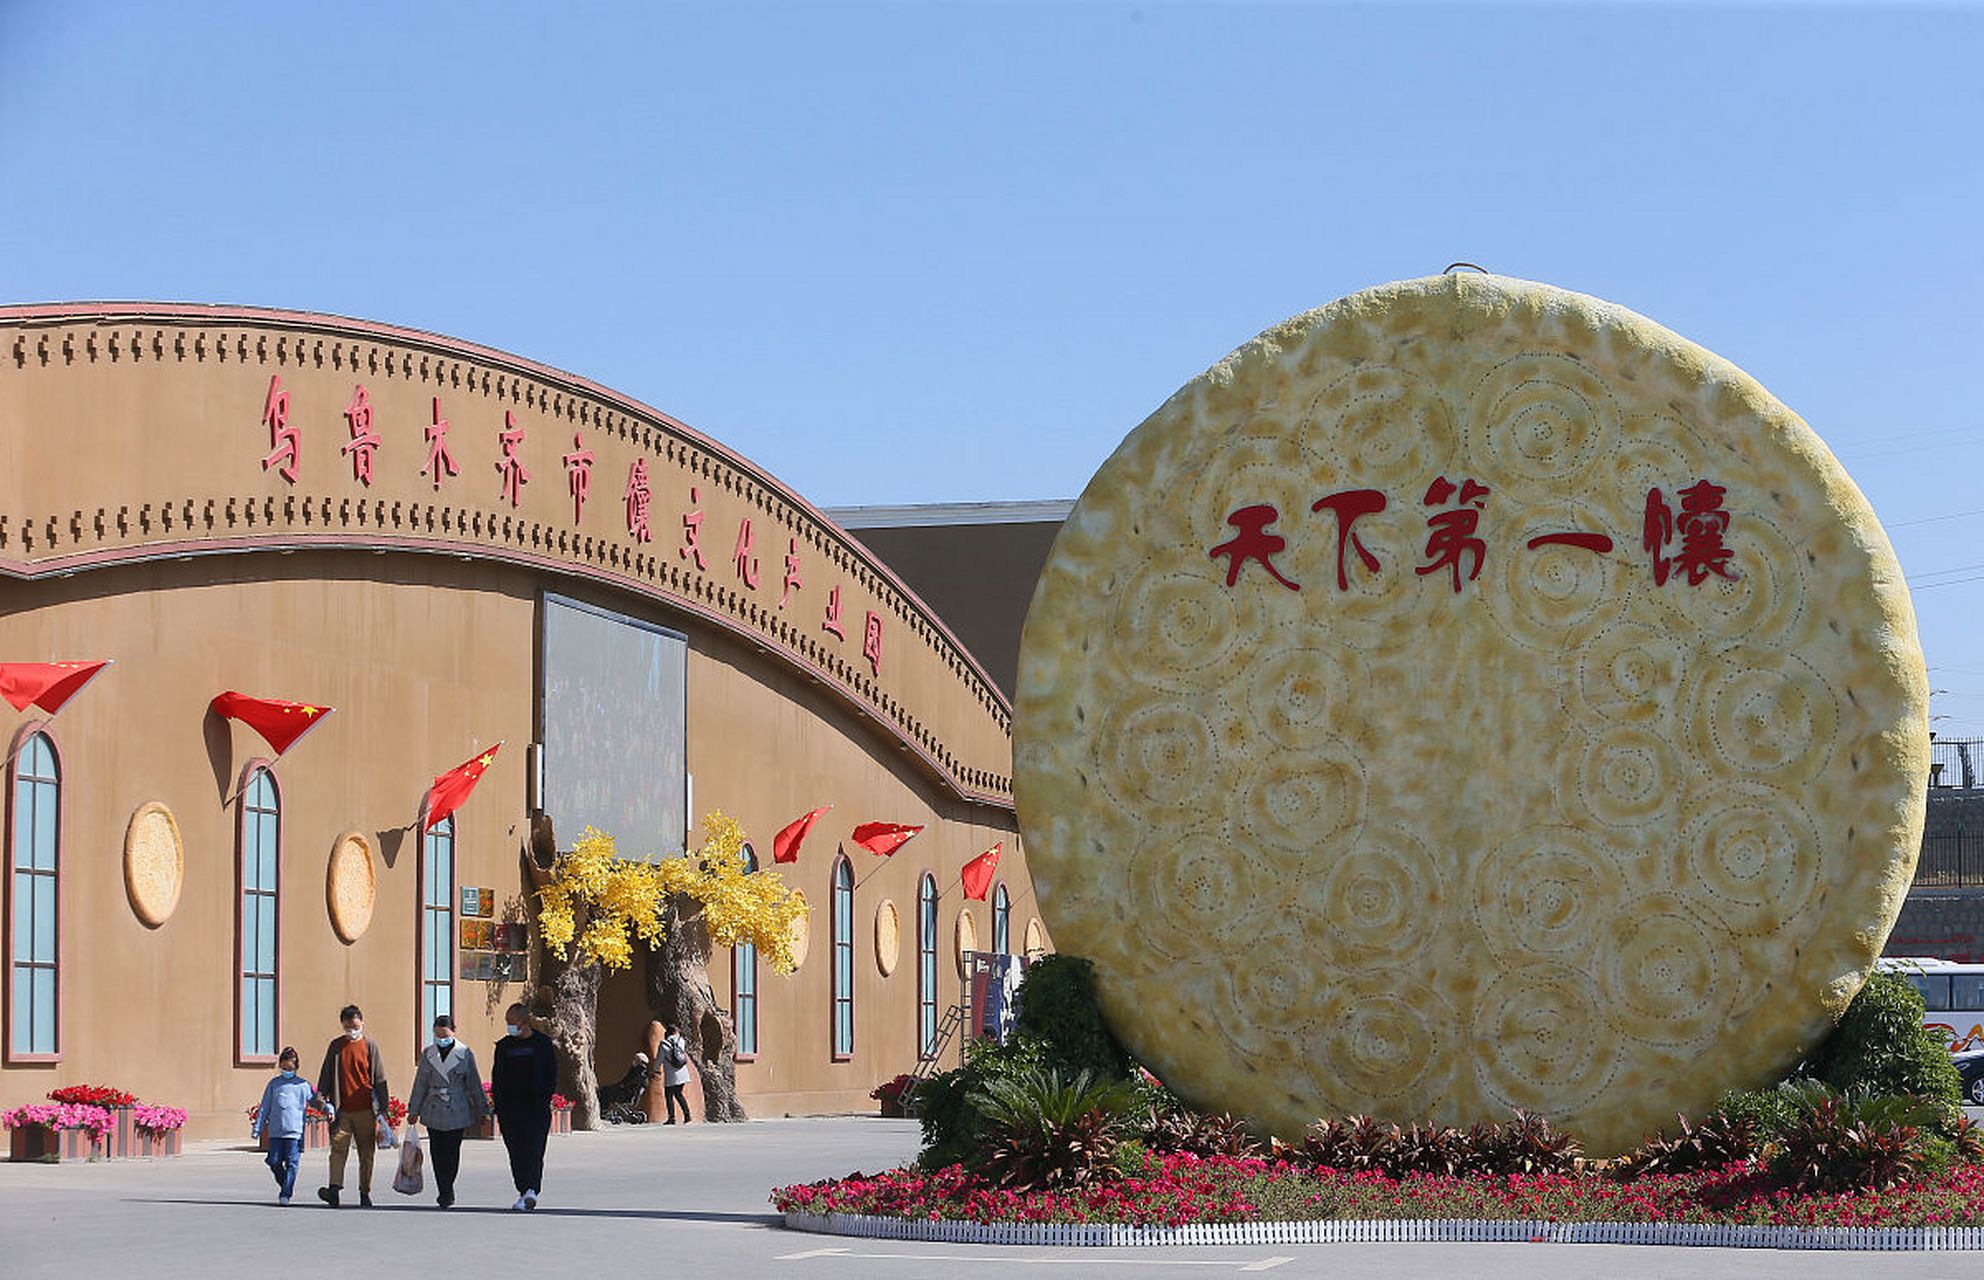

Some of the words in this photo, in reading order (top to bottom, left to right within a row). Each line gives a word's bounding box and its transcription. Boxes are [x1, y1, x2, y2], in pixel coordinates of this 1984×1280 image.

[262, 374, 884, 678] 乌鲁木齐市馕文化产业园
[1210, 479, 1738, 592] 天下第一馕
